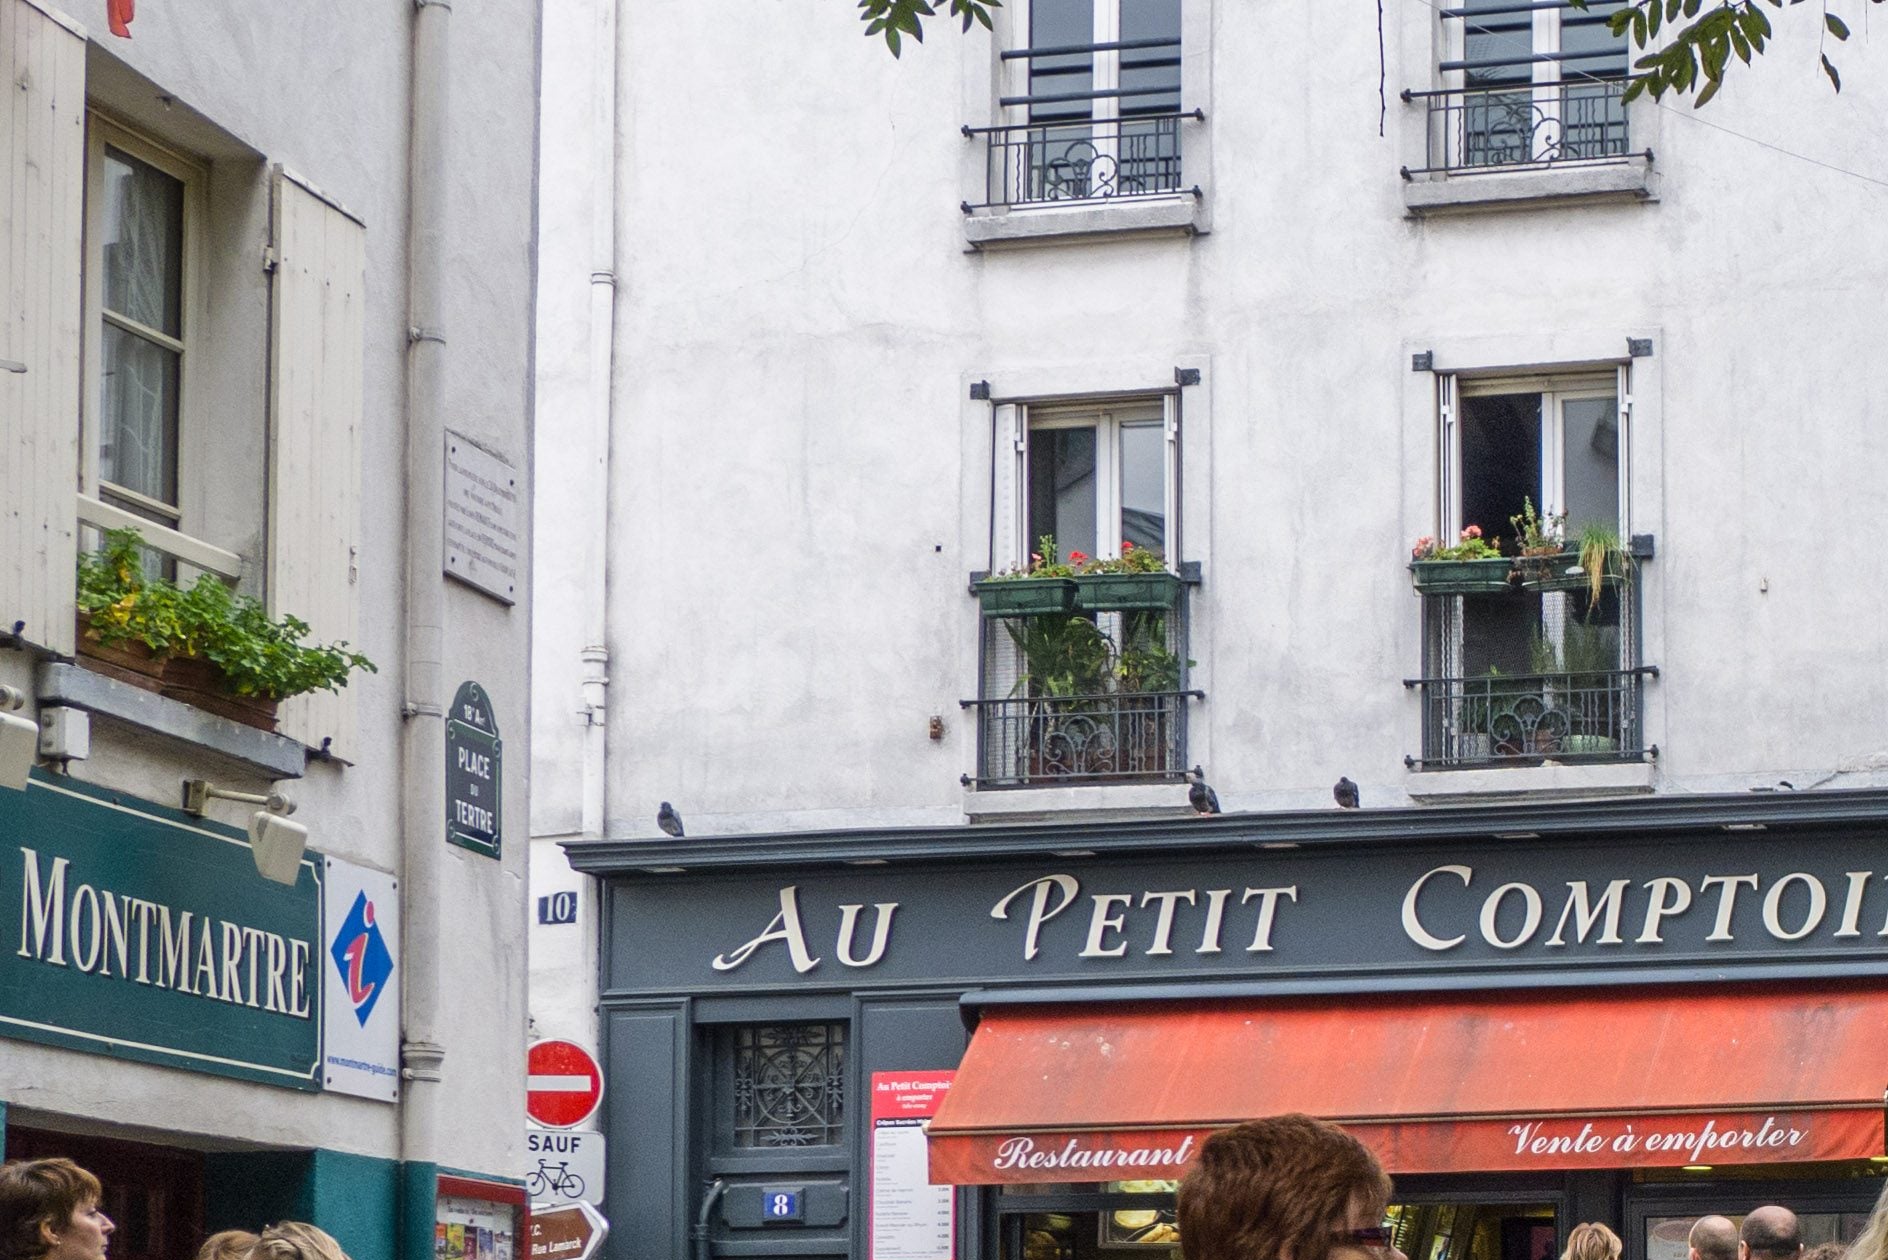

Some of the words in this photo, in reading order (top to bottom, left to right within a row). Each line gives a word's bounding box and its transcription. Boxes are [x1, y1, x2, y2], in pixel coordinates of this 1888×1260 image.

[457, 746, 491, 780] PLACE
[470, 783, 479, 797] DU
[455, 799, 494, 835] TERTRE
[545, 893, 571, 922] 10
[990, 874, 1298, 962] PETIT
[17, 847, 311, 1019] MONTMARTRE
[877, 1083, 889, 1091] Au
[890, 1081, 911, 1091] Petit
[528, 1135, 581, 1153] SAUF
[992, 1134, 1194, 1171] Restaurant
[1508, 1121, 1610, 1156] Vente
[1611, 1125, 1639, 1152] à
[1645, 1116, 1809, 1162] emporter
[773, 1194, 788, 1216] 8
[532, 1243, 547, 1255] Rue
[549, 1238, 582, 1253] Lamarck
